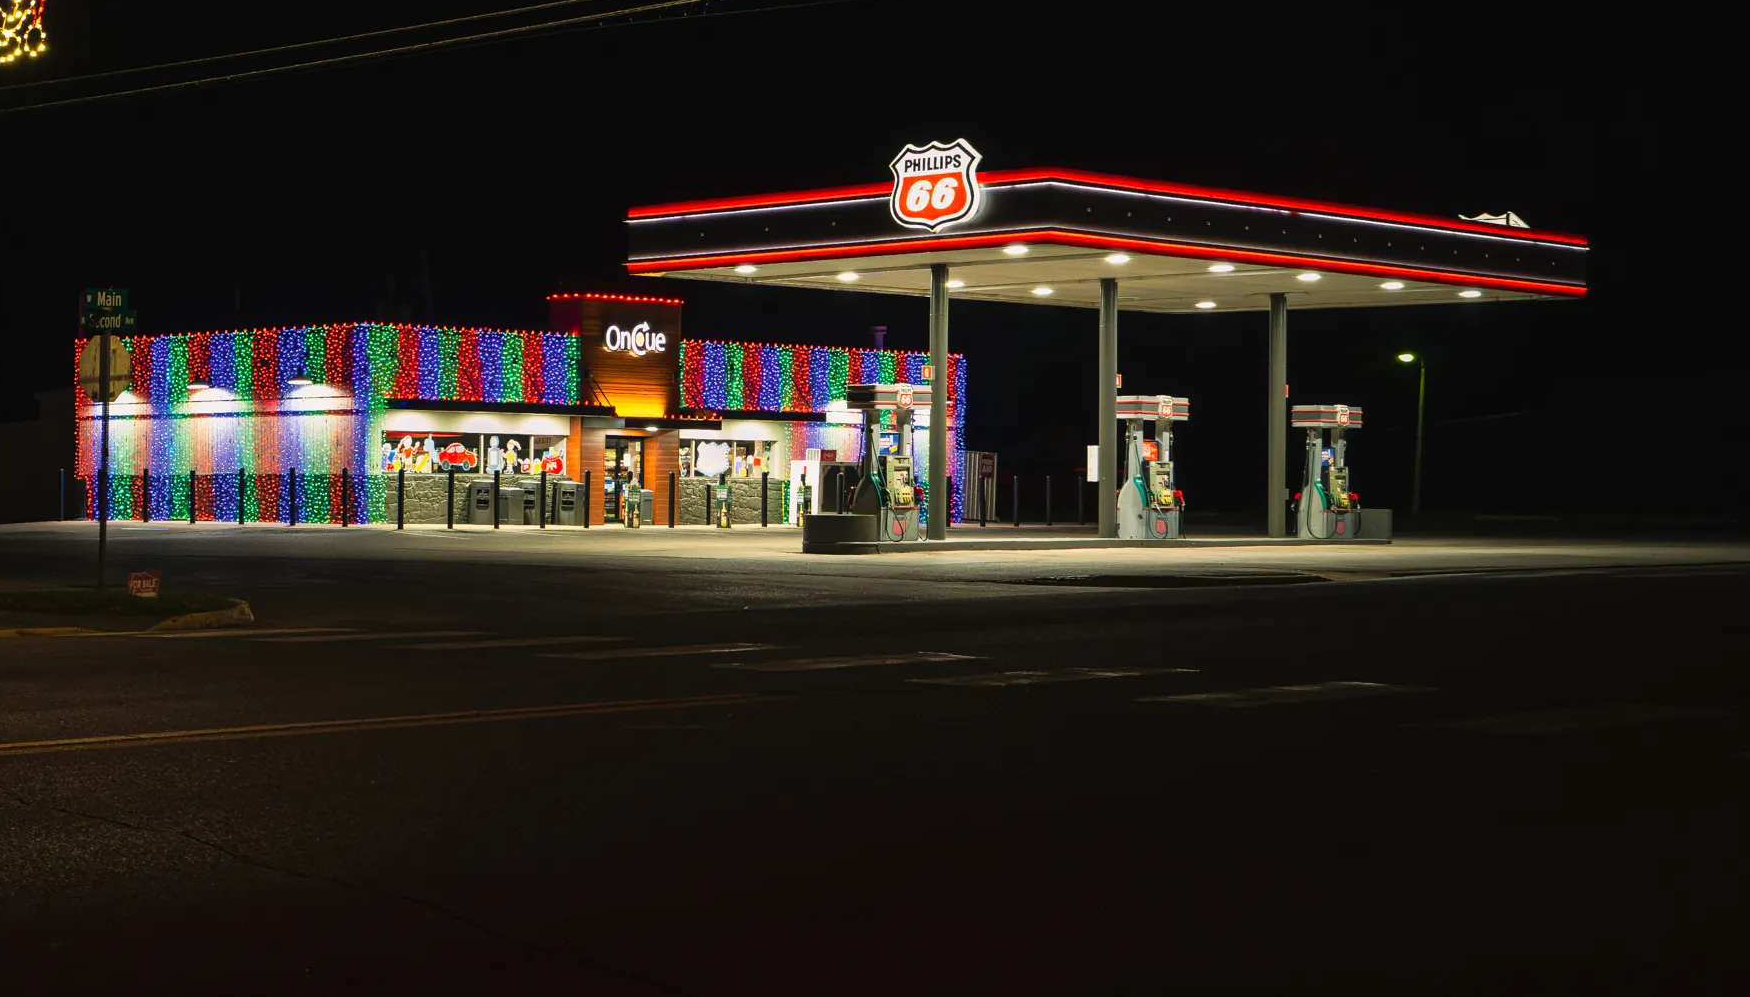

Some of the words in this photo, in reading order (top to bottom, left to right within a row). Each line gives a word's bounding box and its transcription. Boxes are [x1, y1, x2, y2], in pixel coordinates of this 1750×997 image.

[904, 154, 962, 173] PHILLIPS
[906, 177, 959, 212] 66
[97, 291, 122, 306] Main
[89, 313, 121, 328] Scond
[606, 321, 666, 356] OnCue
[901, 394, 912, 405] 66
[130, 579, 141, 590] FOR
[142, 578, 156, 589] SALE
